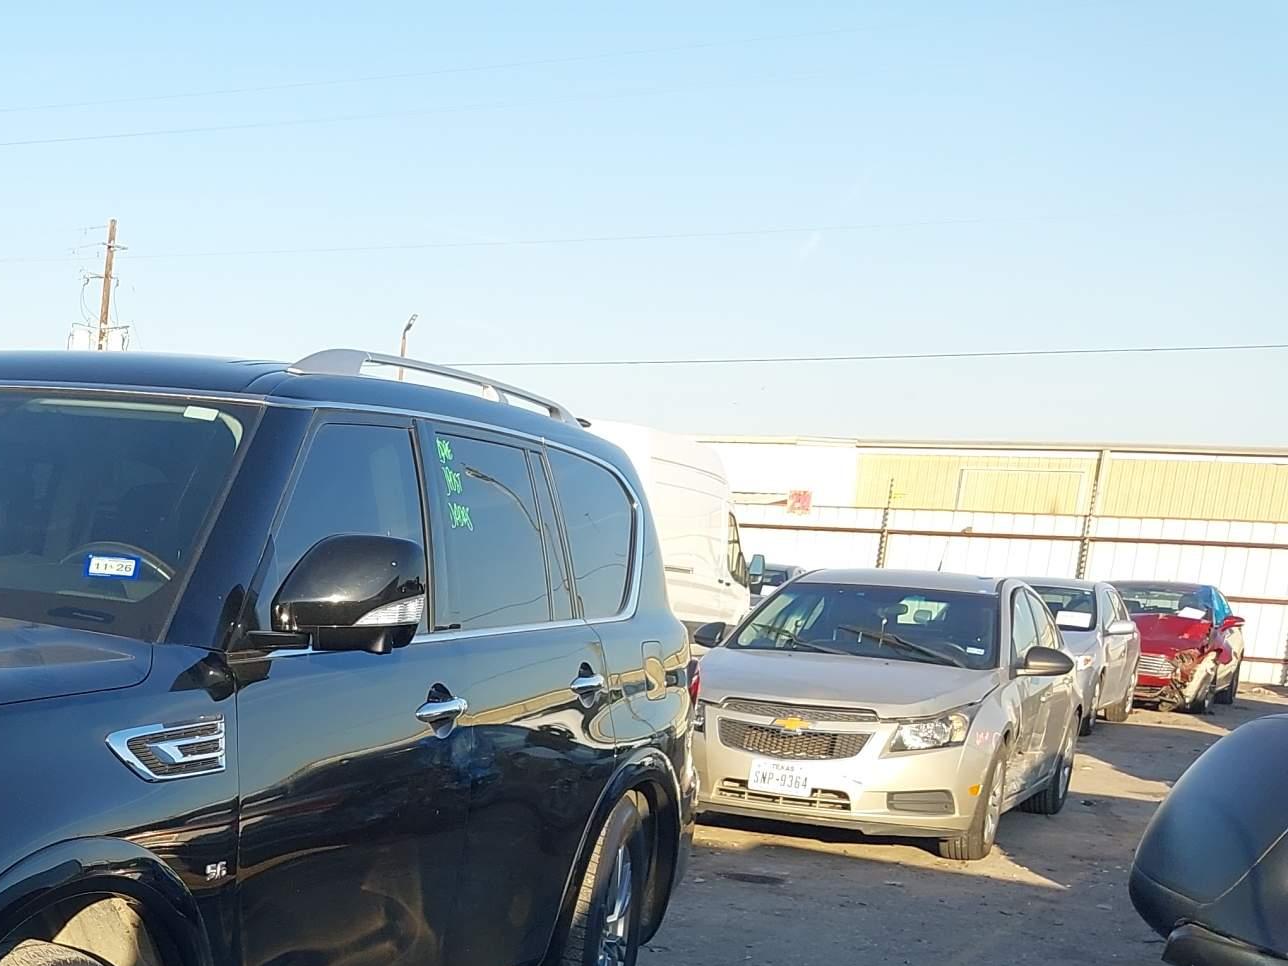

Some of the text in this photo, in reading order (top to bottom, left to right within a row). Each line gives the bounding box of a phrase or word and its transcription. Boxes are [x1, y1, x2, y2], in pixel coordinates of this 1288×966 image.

[95, 562, 132, 573] 11 26
[772, 763, 795, 772] TEXAS
[753, 770, 808, 789] SNP-9364
